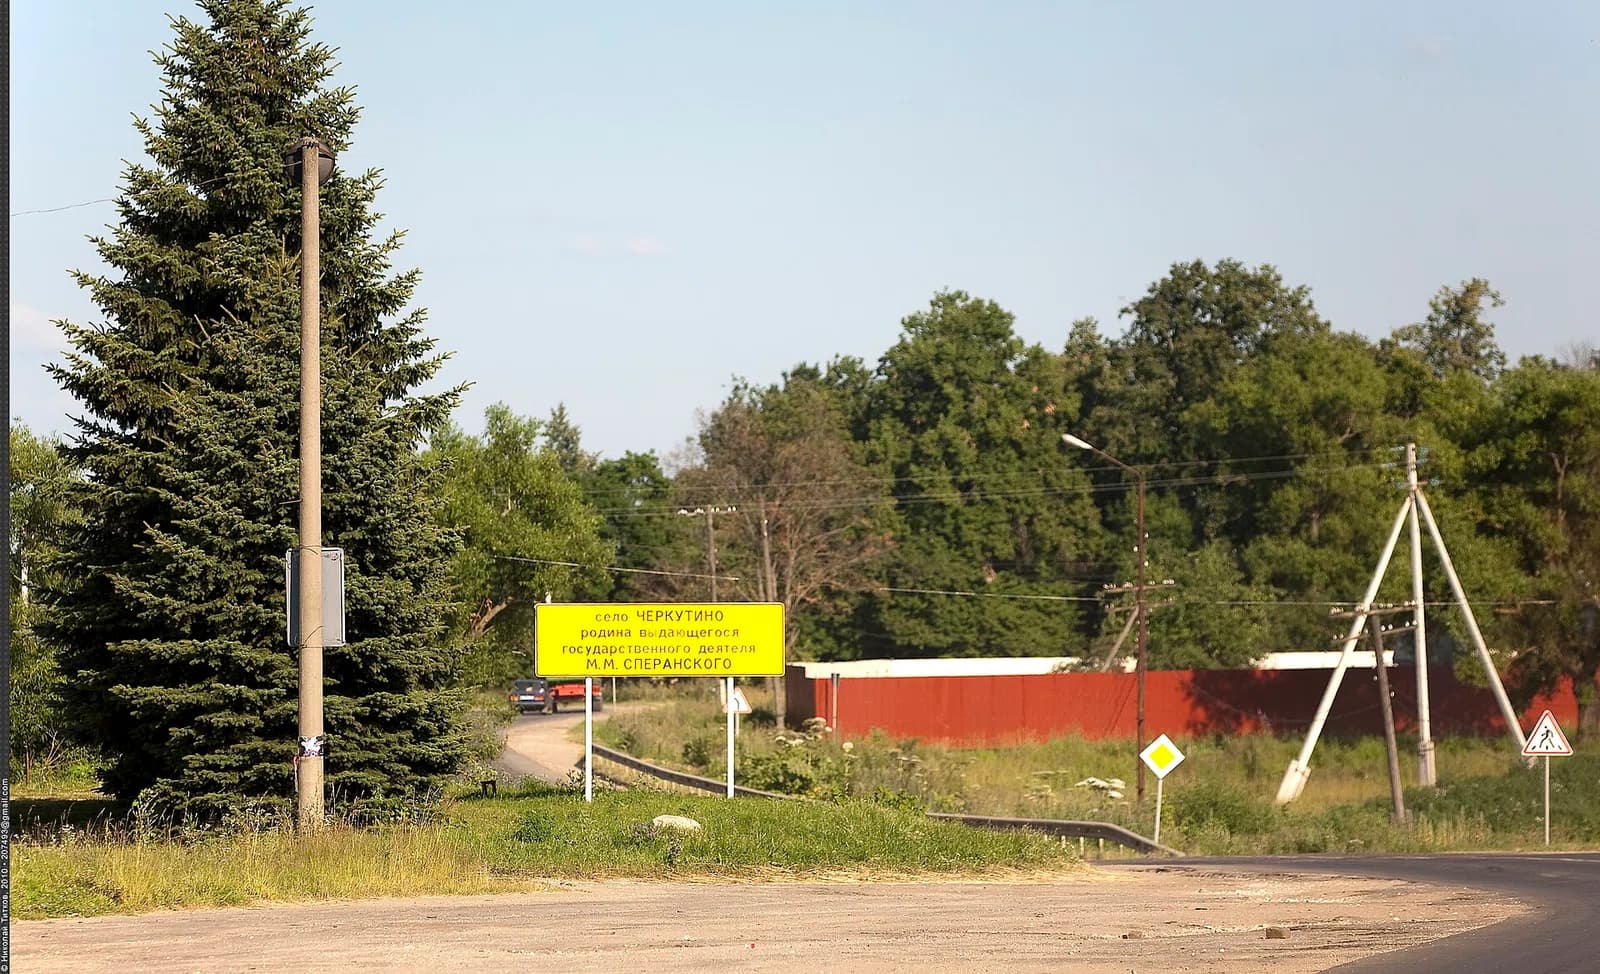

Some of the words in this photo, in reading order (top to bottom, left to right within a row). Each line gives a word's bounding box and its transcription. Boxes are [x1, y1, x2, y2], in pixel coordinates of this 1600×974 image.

[594, 612, 628, 622] село
[636, 610, 724, 622] ЧЕРКУТИНО
[580, 628, 631, 640] родина
[639, 628, 739, 640] выдающегося
[562, 644, 690, 656] государственного
[698, 644, 755, 655] деятеля
[623, 657, 732, 670] СПЕРАНСКОГО
